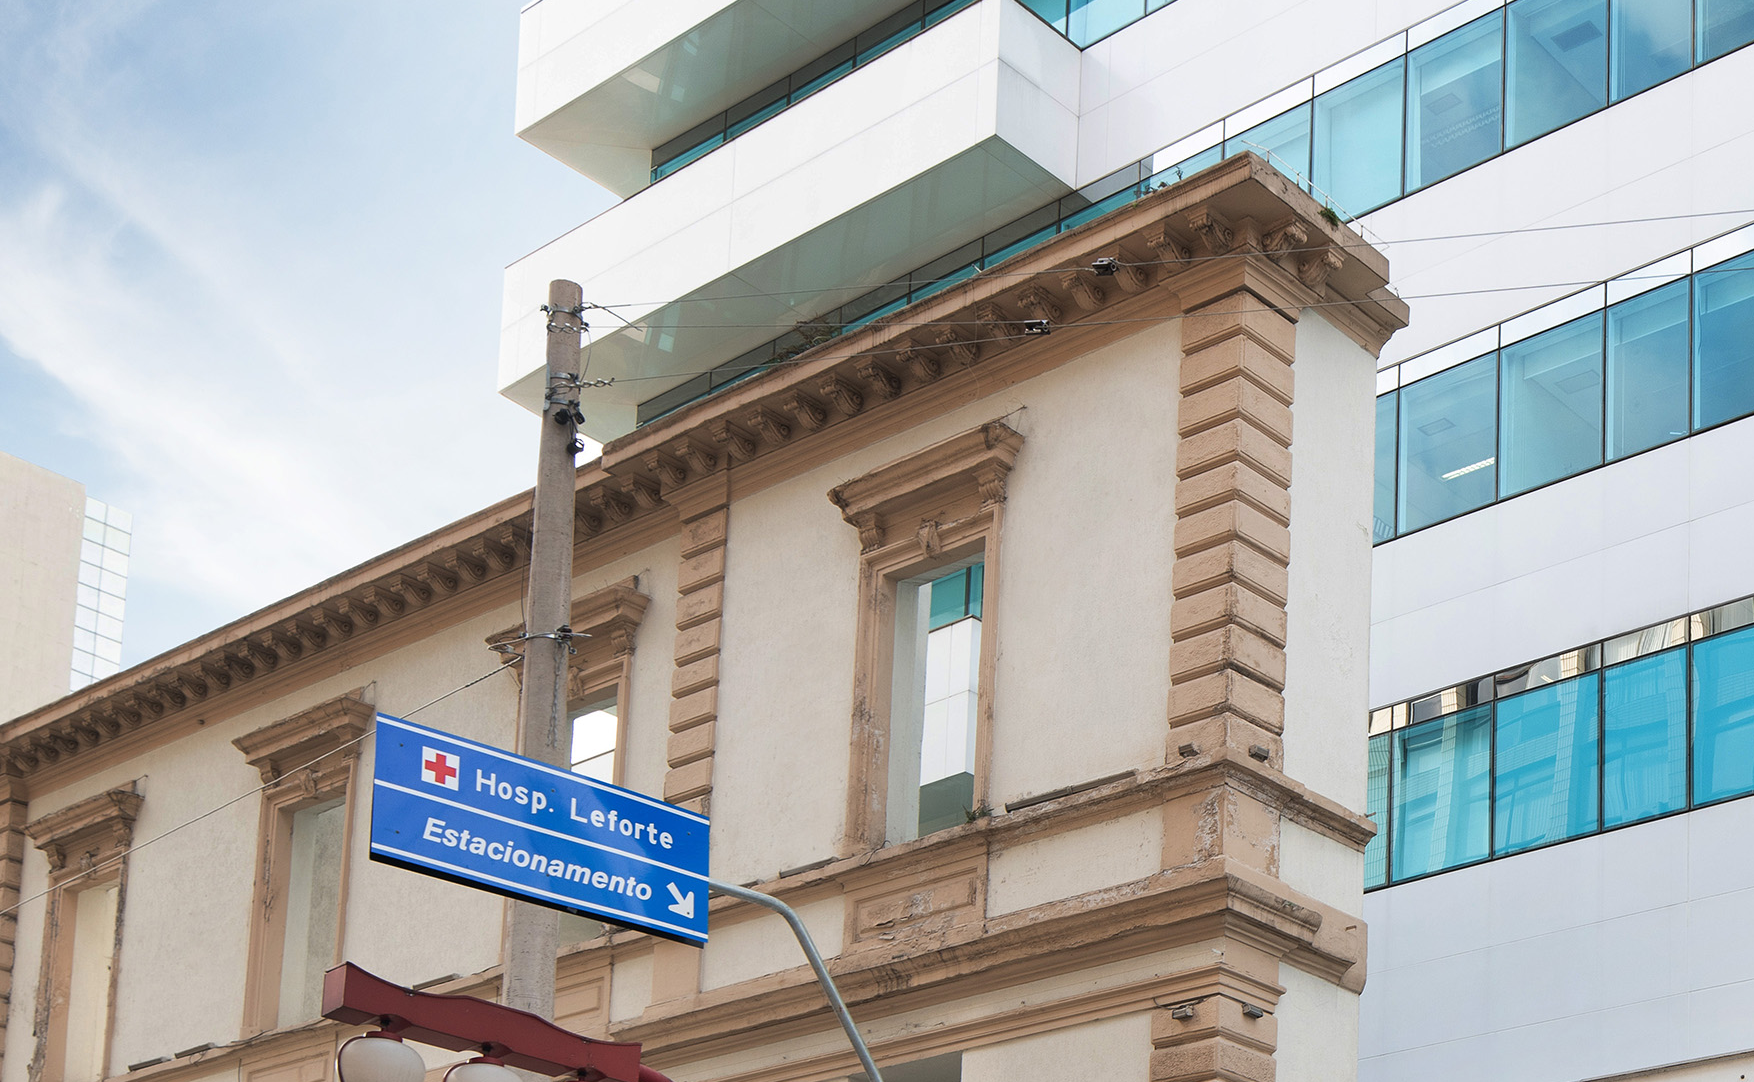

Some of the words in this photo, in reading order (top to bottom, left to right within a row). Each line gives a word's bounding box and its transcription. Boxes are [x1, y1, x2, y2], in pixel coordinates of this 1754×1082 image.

[476, 769, 554, 813] Hosp.
[570, 798, 674, 850] Leforte
[422, 817, 652, 901] Estacionamento
